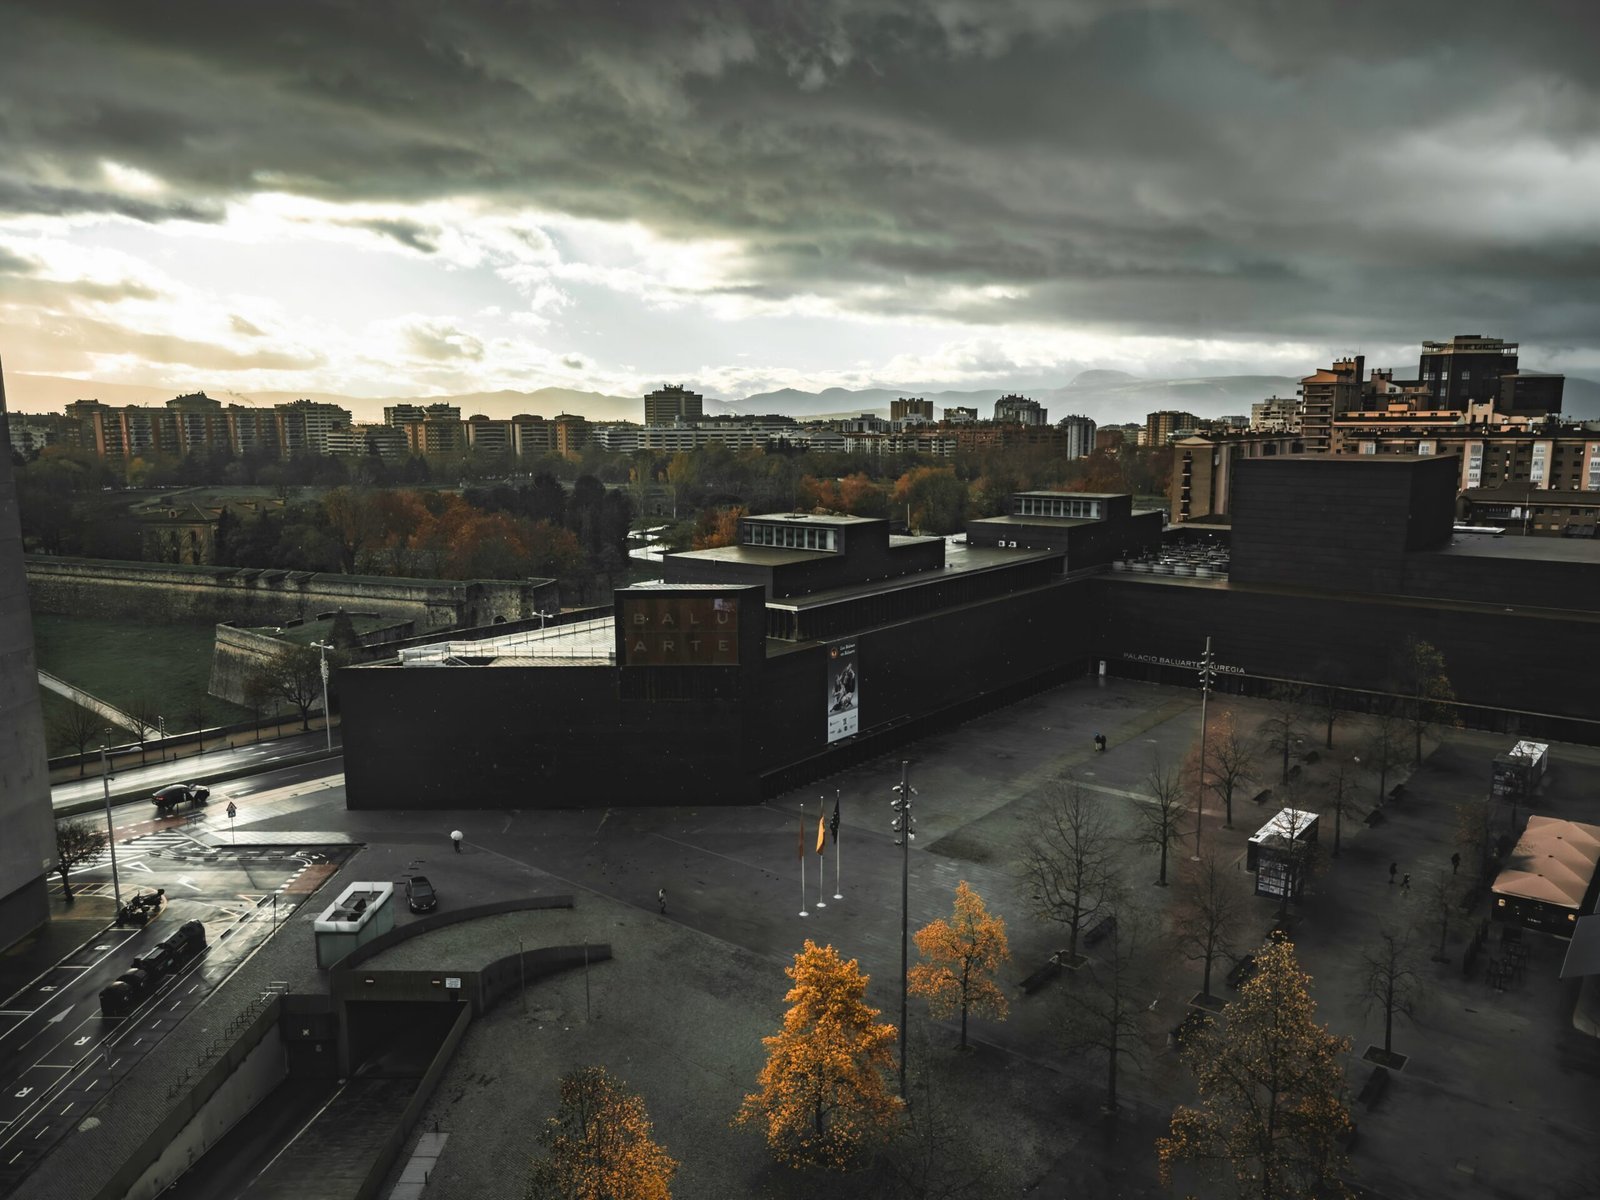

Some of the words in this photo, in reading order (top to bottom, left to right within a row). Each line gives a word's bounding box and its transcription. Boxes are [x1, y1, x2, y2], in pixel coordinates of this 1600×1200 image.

[633, 612, 730, 625] BALU
[633, 640, 730, 652] ARTE
[1123, 652, 1158, 662] PALACIO
[1159, 657, 1201, 669] BALUARTE
[1203, 663, 1245, 674] AUREGIA
